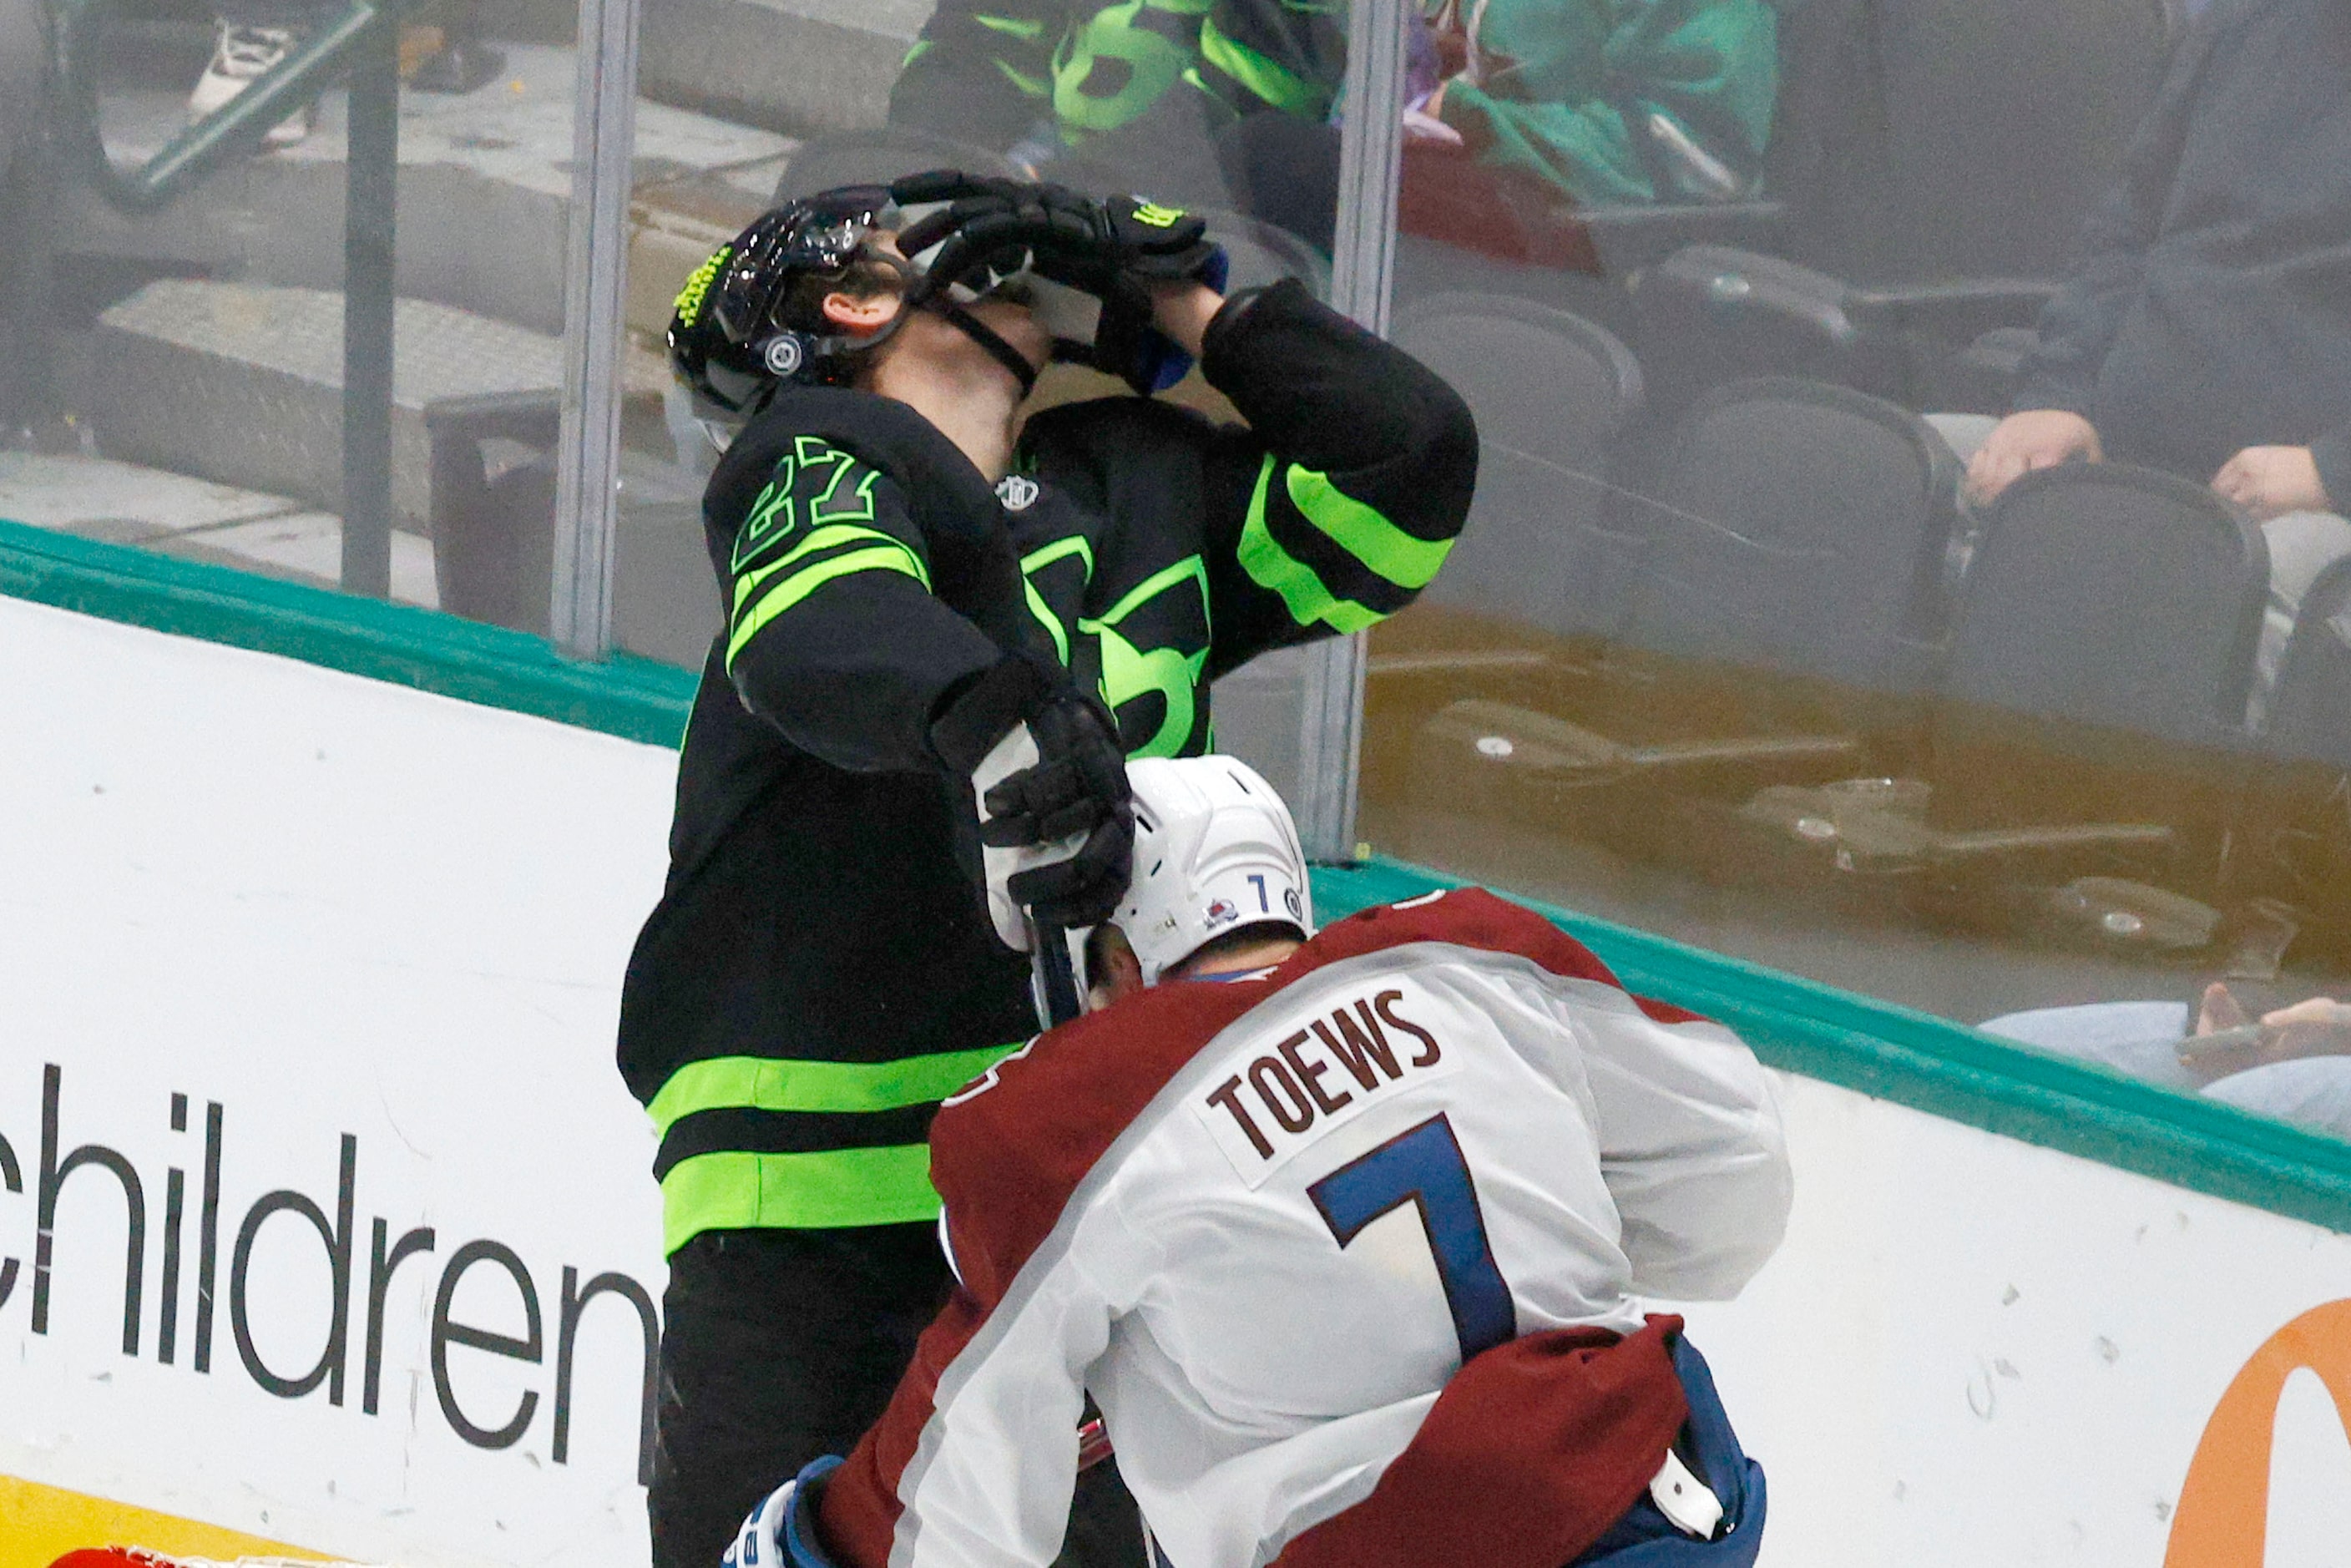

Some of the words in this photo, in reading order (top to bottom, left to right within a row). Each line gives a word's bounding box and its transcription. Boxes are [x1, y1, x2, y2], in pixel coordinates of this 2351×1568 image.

[731, 434, 882, 575] 27
[1247, 874, 1270, 914] 7
[1206, 989, 1442, 1161] TOEWS
[0, 1062, 661, 1485] hildren
[1305, 1110, 1518, 1368] 7
